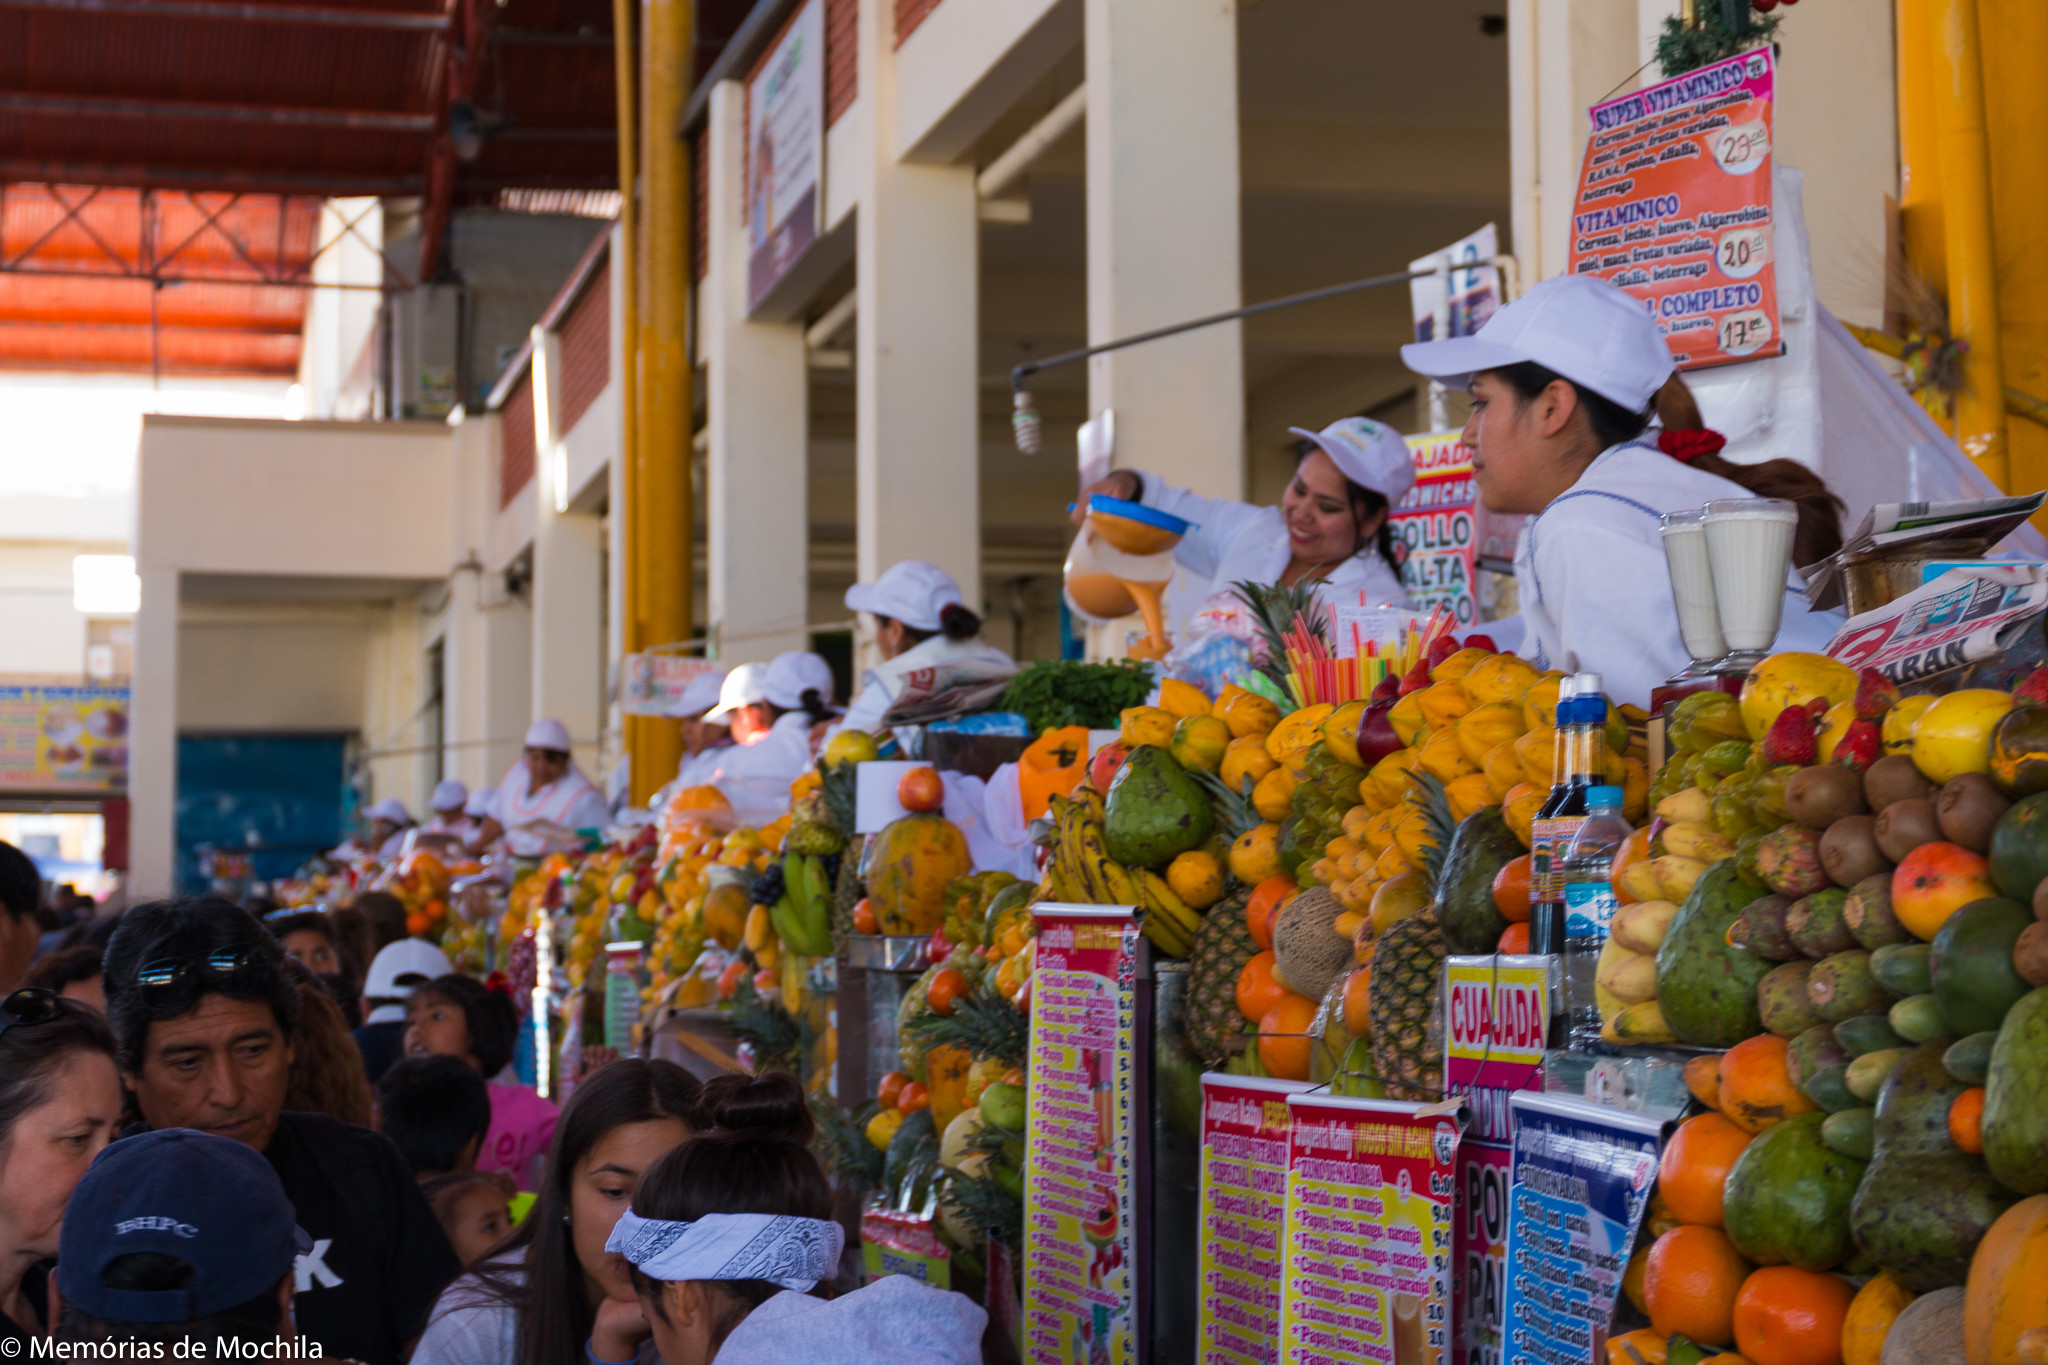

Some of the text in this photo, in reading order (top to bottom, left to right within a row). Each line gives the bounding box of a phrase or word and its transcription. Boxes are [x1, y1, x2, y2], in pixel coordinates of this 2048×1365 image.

[1595, 61, 1745, 132] SUPER VITAMINICO
[1575, 194, 1680, 234] VITAMINICO
[1661, 283, 1762, 318] COMPLETO
[1449, 981, 1544, 1050] CUAJADA
[114, 1216, 199, 1238] BHPC
